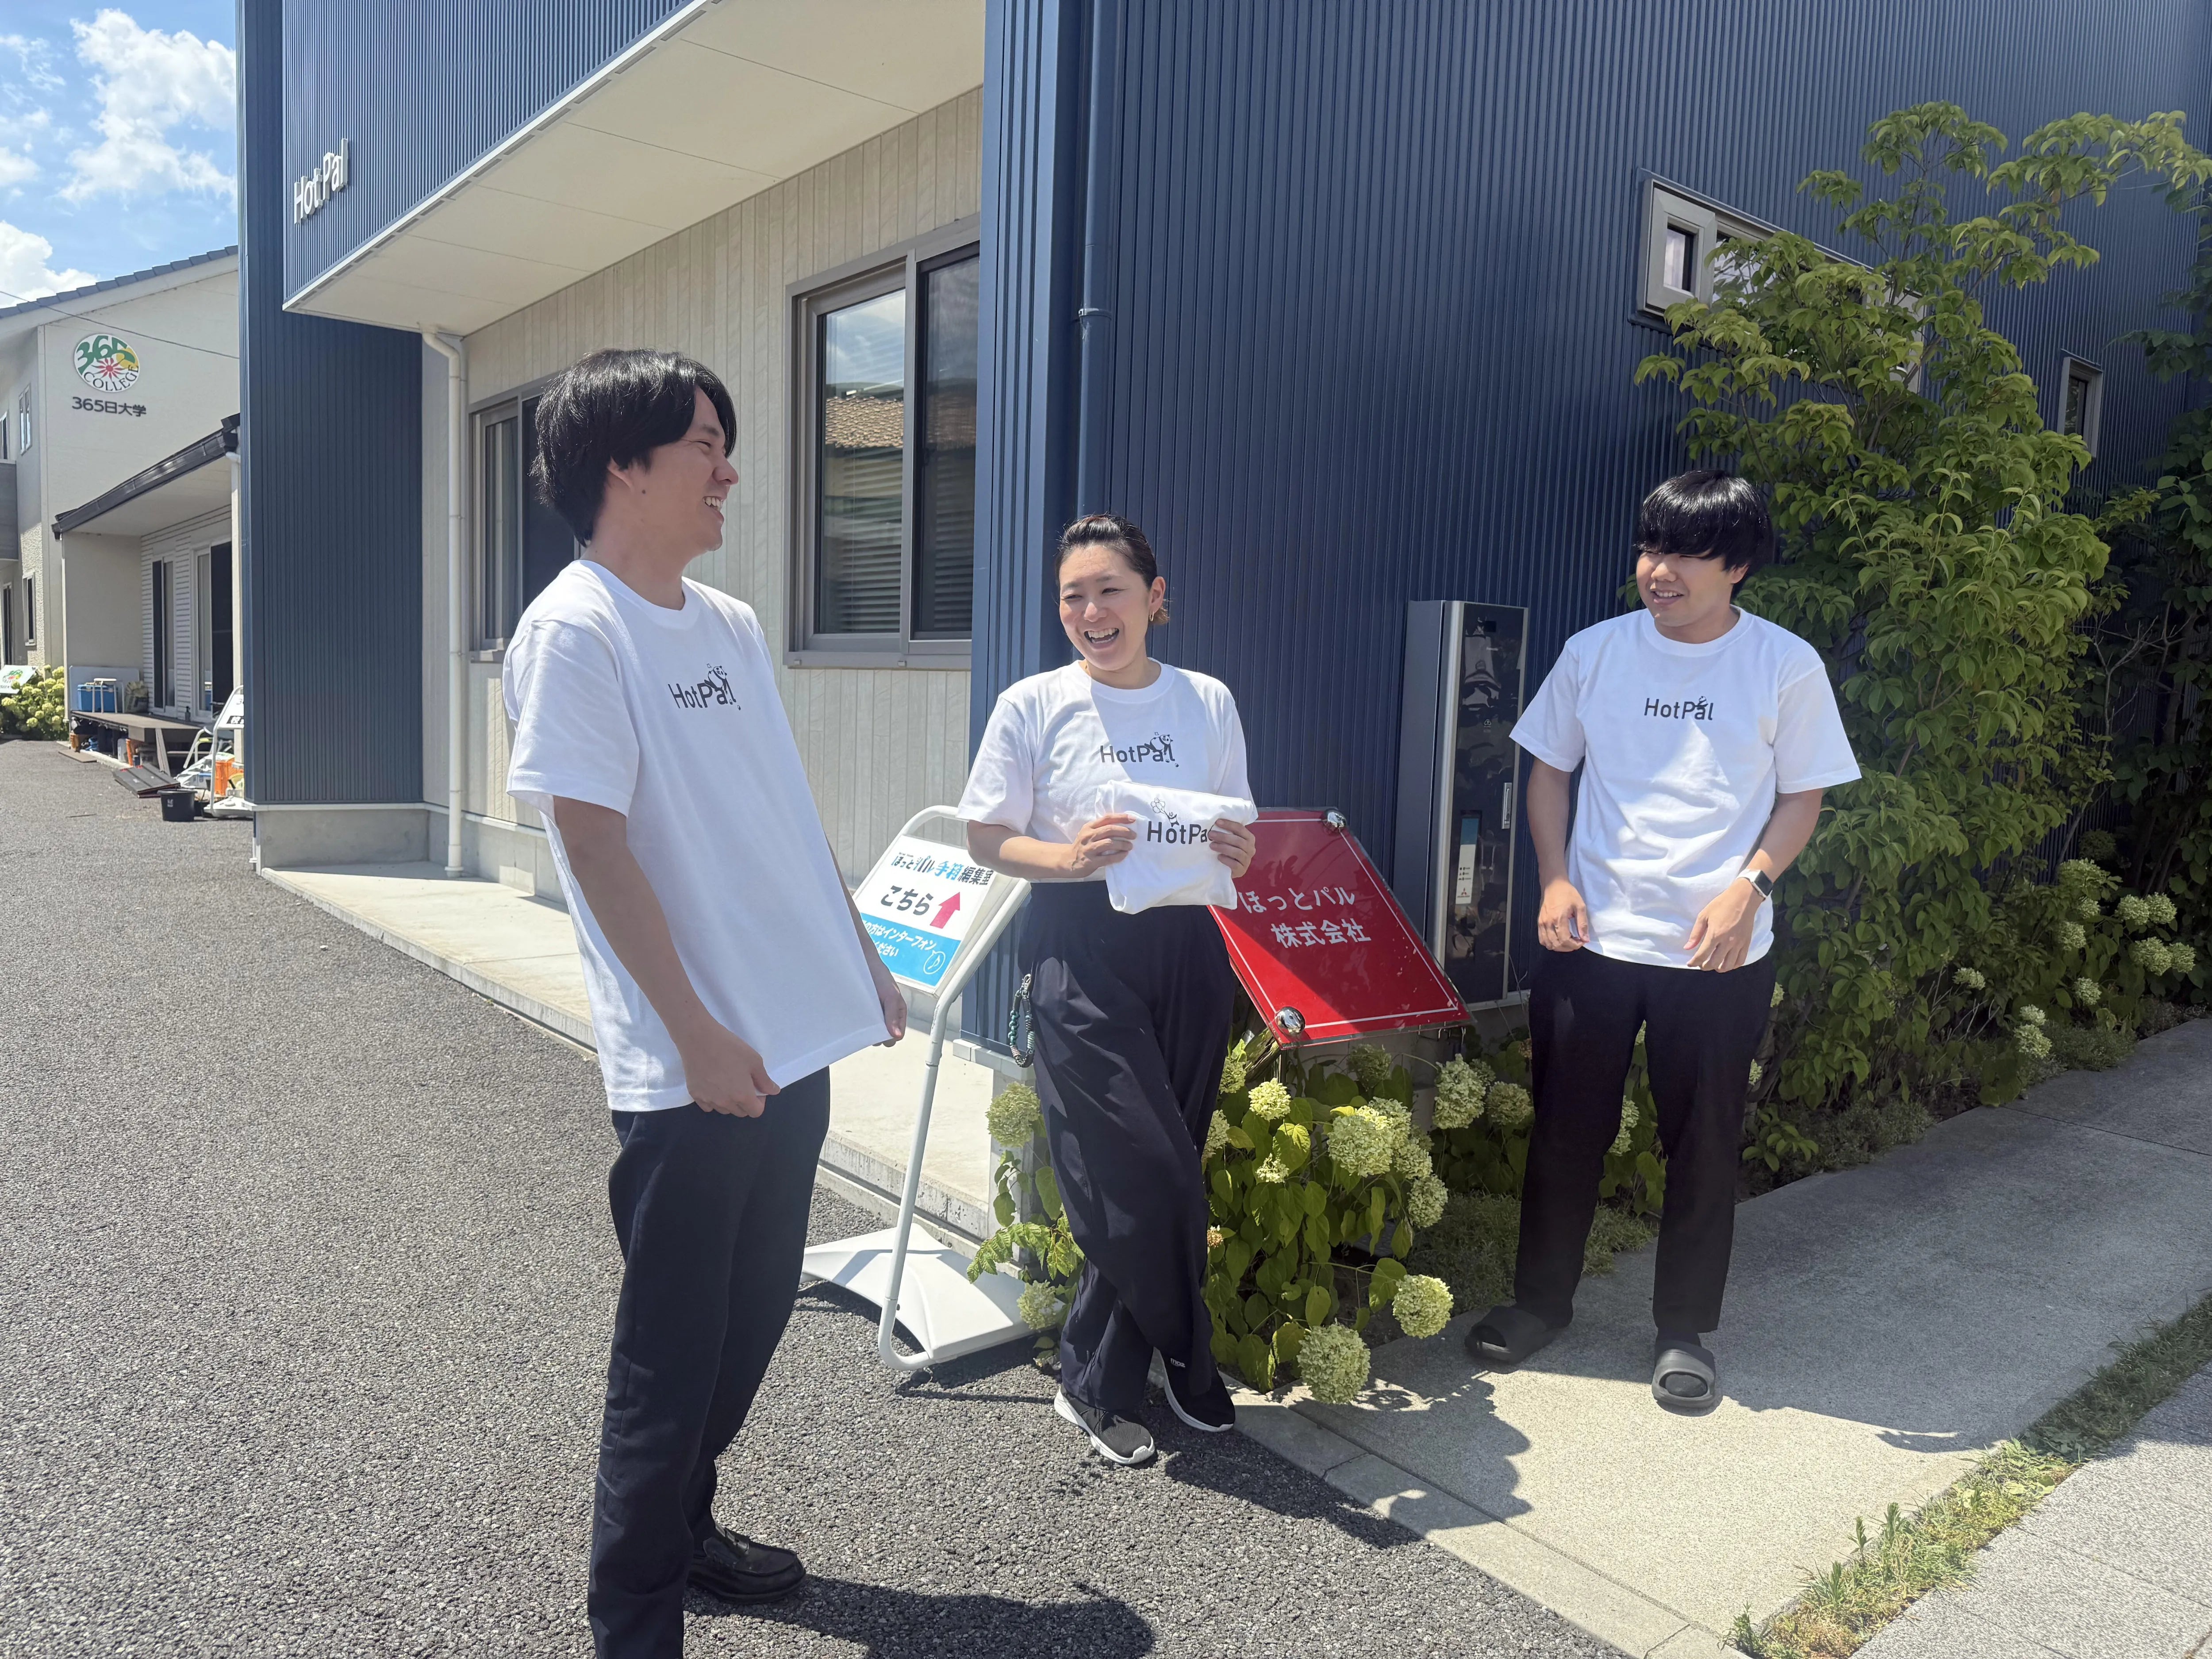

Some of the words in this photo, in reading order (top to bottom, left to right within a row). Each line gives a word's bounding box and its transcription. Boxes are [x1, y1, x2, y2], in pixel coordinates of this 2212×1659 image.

[294, 168, 323, 225] Hot
[323, 137, 349, 201] Pal
[76, 335, 135, 376] 365
[84, 364, 139, 391] COLLEGE
[72, 396, 147, 417] 365日大学
[668, 677, 737, 709] HotPal
[1644, 698, 1714, 721] HotPal
[1100, 743, 1175, 763] HotPal
[881, 885, 933, 915] こちら
[1238, 886, 1355, 914] ほっとパル
[863, 920, 937, 951] の方はインターフォン
[1270, 918, 1371, 949] 株式会社
